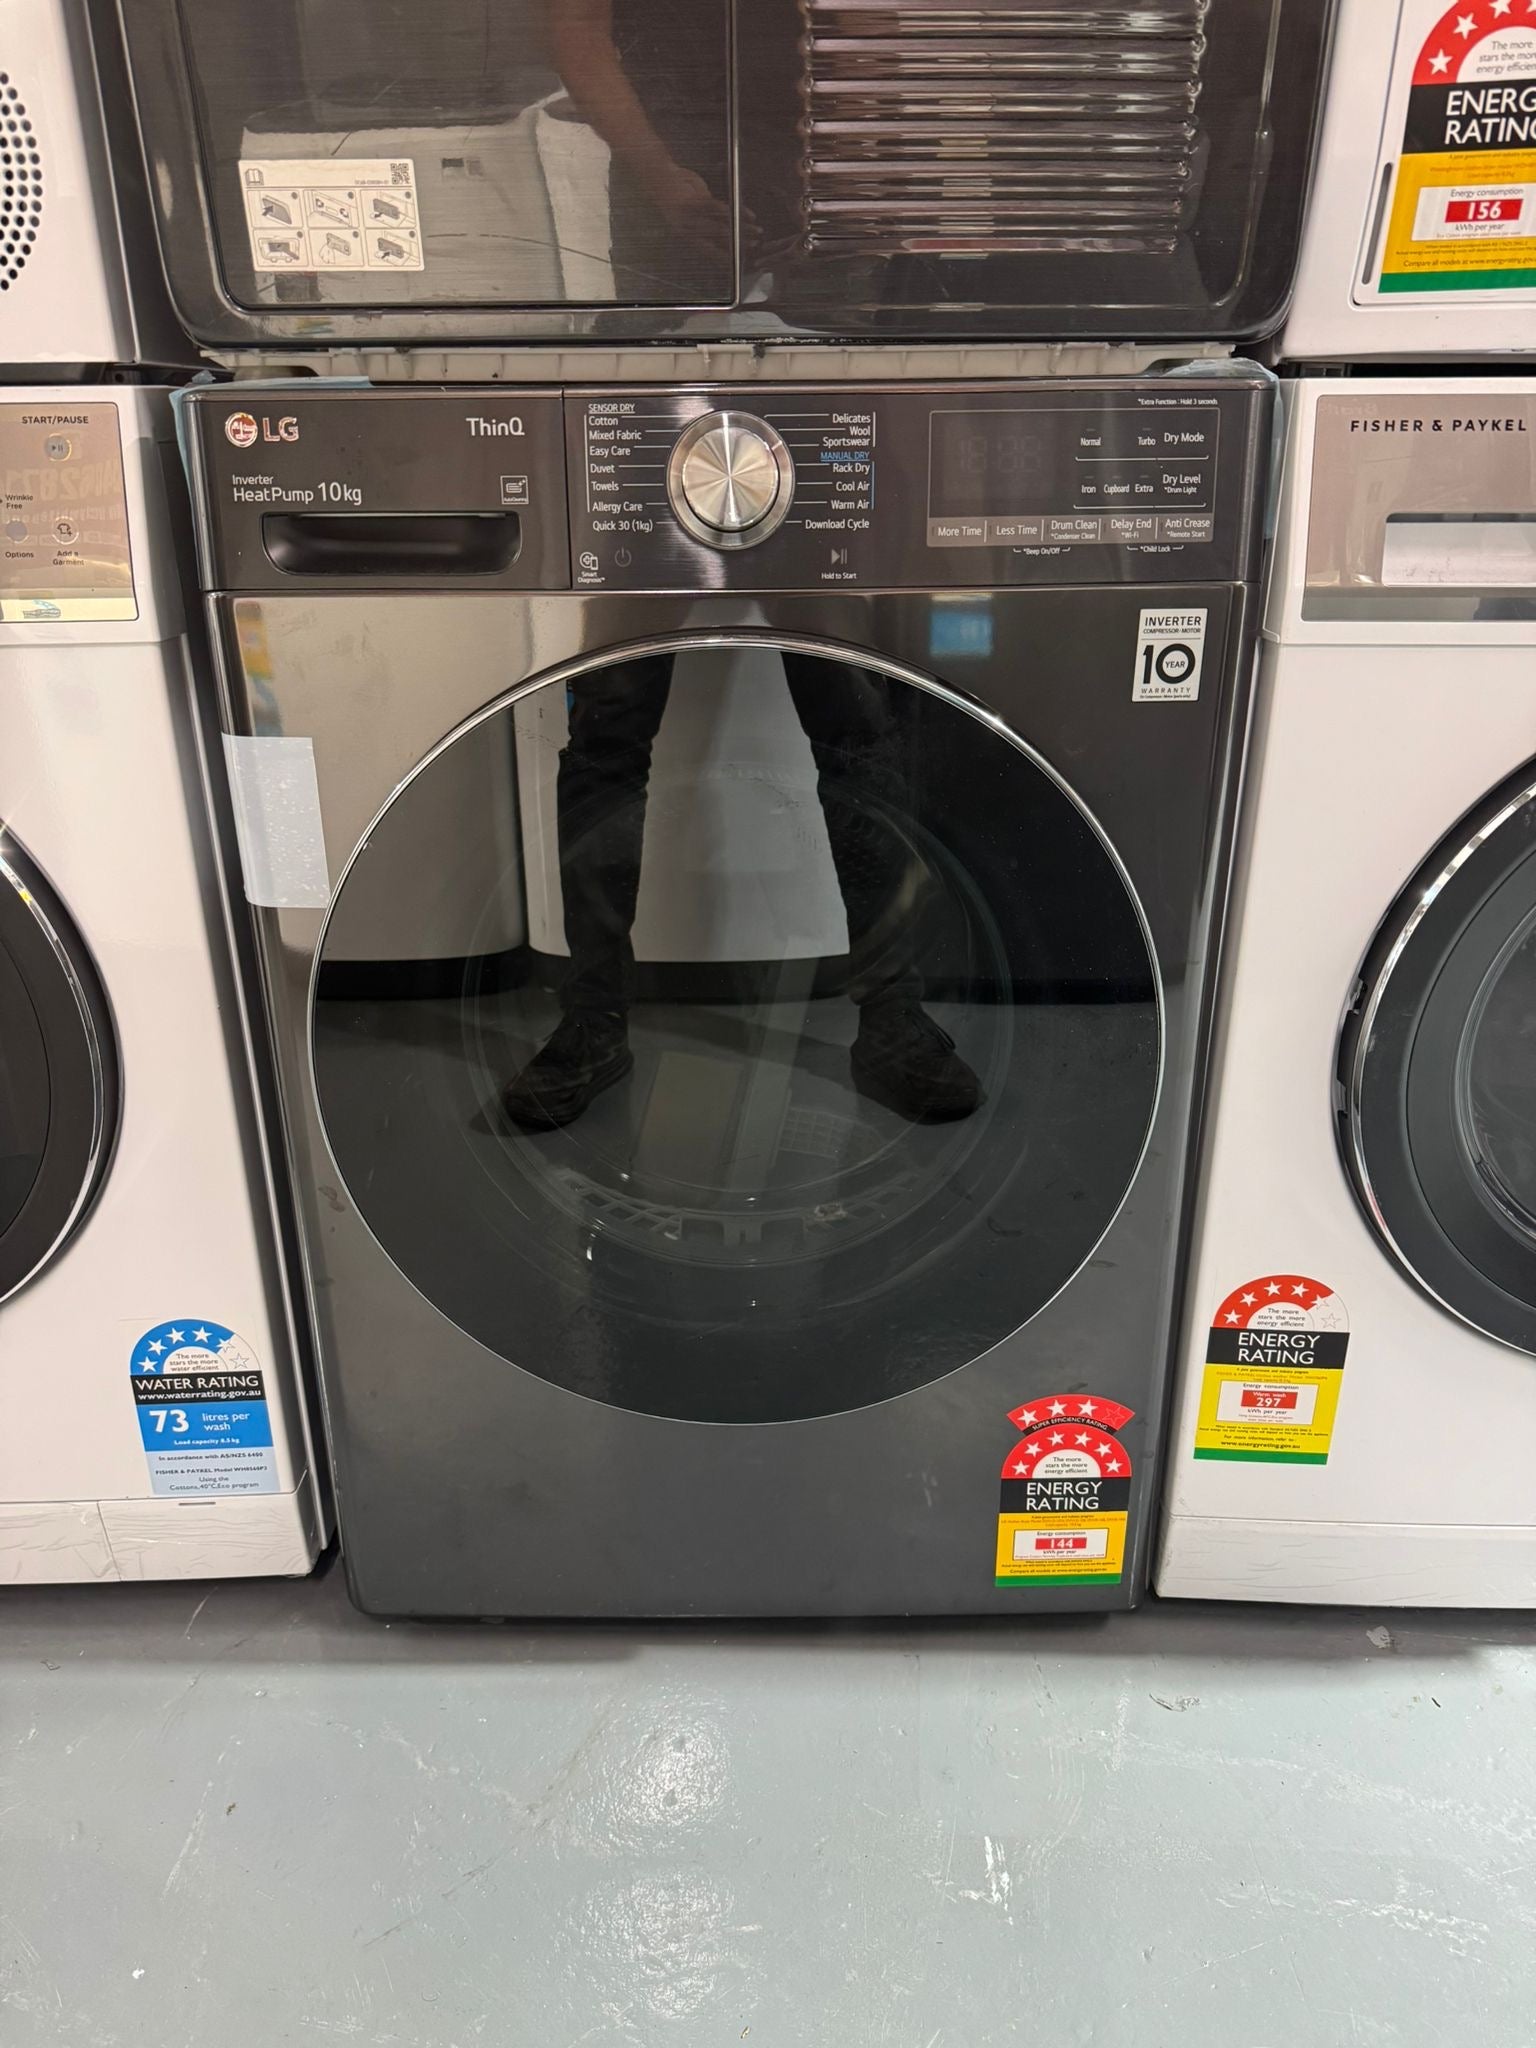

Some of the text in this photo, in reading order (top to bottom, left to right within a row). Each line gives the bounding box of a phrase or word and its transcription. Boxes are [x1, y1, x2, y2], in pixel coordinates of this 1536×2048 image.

[1492, 40, 1508, 50] The
[1480, 52, 1536, 62] stars the mor
[1476, 65, 1504, 75] energy
[1444, 116, 1536, 145] RATIN
[1450, 188, 1524, 199] Energy consumption
[1467, 202, 1503, 220] 156
[1455, 222, 1505, 233] kWh per year
[588, 402, 635, 412] SENSOR DRY
[21, 415, 90, 425] START/PAUSE
[588, 416, 618, 426] Cotton
[832, 413, 871, 424] Delicates
[262, 416, 300, 442] LG
[466, 416, 525, 437] ThinQ
[1350, 418, 1527, 432] FISHER & PAYKEL
[589, 429, 642, 440] Mixed Fabric
[849, 426, 871, 436] Wool
[822, 436, 870, 448] Sportswear
[1080, 436, 1101, 446] Normal
[1138, 436, 1156, 446] Turbo
[1164, 432, 1204, 444] Dry Mode
[589, 445, 631, 458] Easy Care
[820, 451, 870, 460] MANUAL DRY
[590, 463, 615, 474] Duvet
[832, 462, 870, 474] Rack Dry
[232, 474, 274, 486] Inverter
[1163, 473, 1200, 486] Dry Level
[591, 481, 620, 491] Towels
[836, 480, 870, 492] Cool Air
[1081, 484, 1096, 494] Iron
[1104, 484, 1130, 495] Cupboard
[1135, 484, 1154, 493] Extra
[1183, 486, 1197, 494] Light
[592, 501, 643, 514] Allergy Care
[831, 500, 870, 510] Warm Air
[592, 519, 653, 533] Quick 30 (1kg)
[805, 518, 870, 532] Download Cycle
[1051, 520, 1098, 530] Drum Clean
[1111, 518, 1152, 531] Delay End
[1165, 518, 1210, 528] Anti Crease
[938, 526, 982, 536] More Time
[996, 524, 1038, 536] Less Time
[1192, 530, 1206, 538] Start
[1081, 532, 1096, 540] Clean
[52, 558, 84, 566] Garment
[821, 572, 857, 580] Hold to Start
[1145, 616, 1202, 626] INVERTER
[1143, 643, 1196, 684] 10
[1165, 660, 1186, 668] YEAR
[1238, 1332, 1320, 1349] ENERGY
[1238, 1349, 1315, 1364] RATING
[136, 1375, 259, 1391] WATER RATING
[1242, 1382, 1262, 1390] Energy
[138, 1389, 261, 1400] www.waterrating.gov.au
[1256, 1397, 1282, 1408] 297
[149, 1408, 250, 1433] 73 litres per
[1032, 1416, 1108, 1430] SUPER EFFICIENCY RATING
[204, 1422, 231, 1432] wash
[1026, 1482, 1102, 1496] ENERGY
[1026, 1496, 1100, 1511] RATING
[1050, 1538, 1074, 1549] 144
